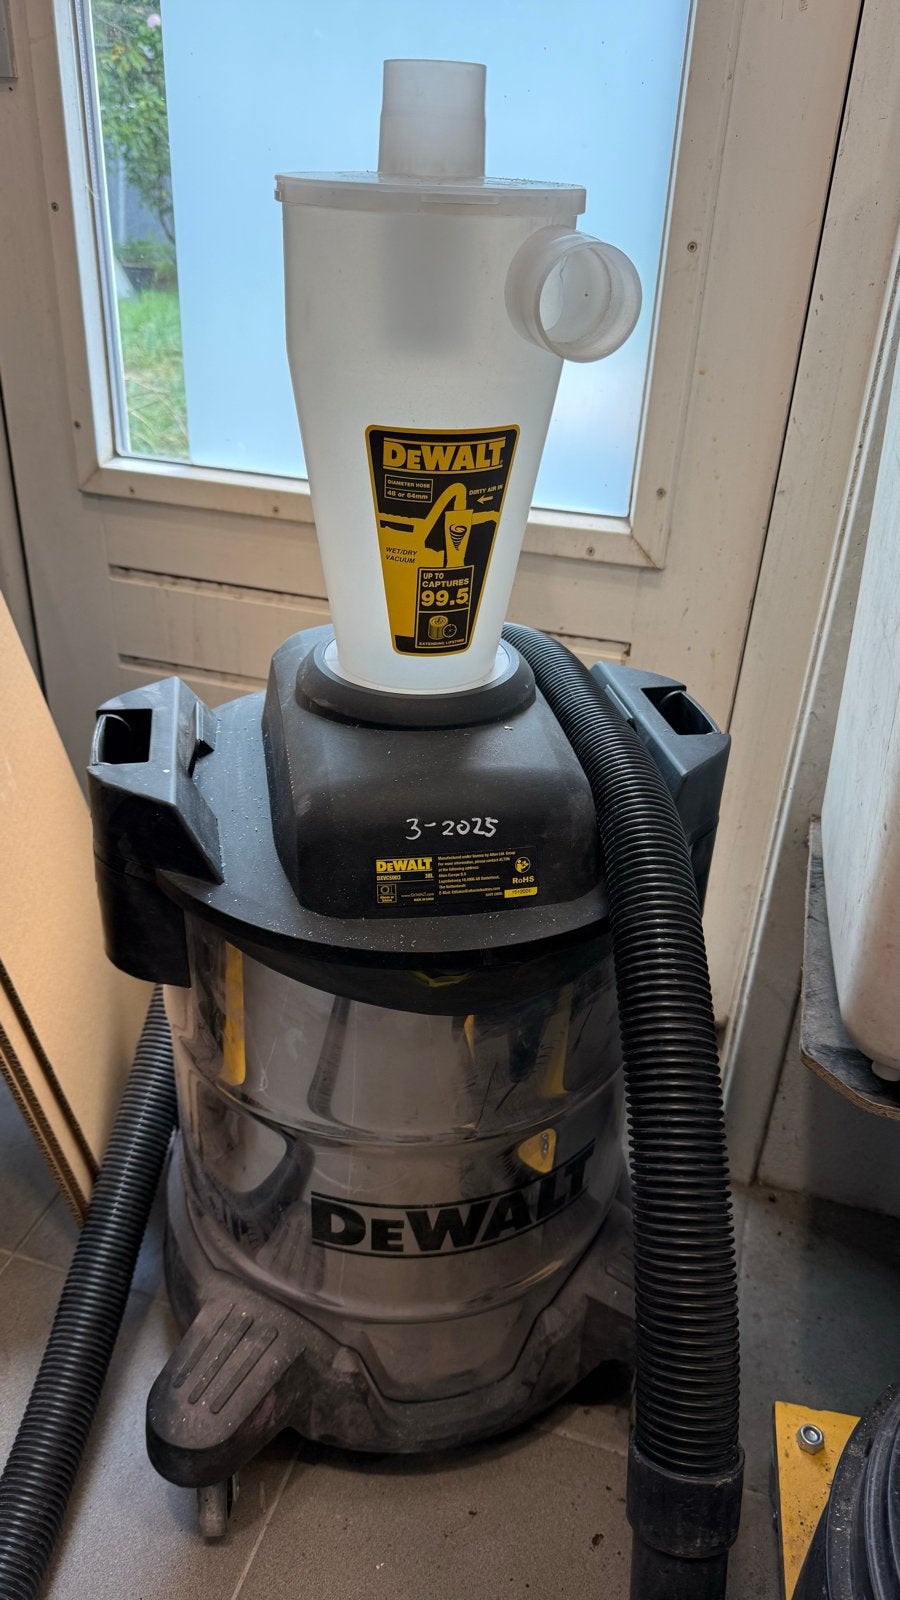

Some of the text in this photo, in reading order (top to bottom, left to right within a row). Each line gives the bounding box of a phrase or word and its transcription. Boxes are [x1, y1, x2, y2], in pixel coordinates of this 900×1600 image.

[387, 479, 414, 488] DIAMETER
[406, 492, 428, 500] 64mm
[468, 488, 486, 496] DIRTY
[386, 546, 418, 556] WET/DRY
[386, 554, 416, 564] VACUUM
[422, 578, 469, 588] CAPTURES
[405, 817, 498, 840] 3-2025
[512, 876, 535, 884] RoHS
